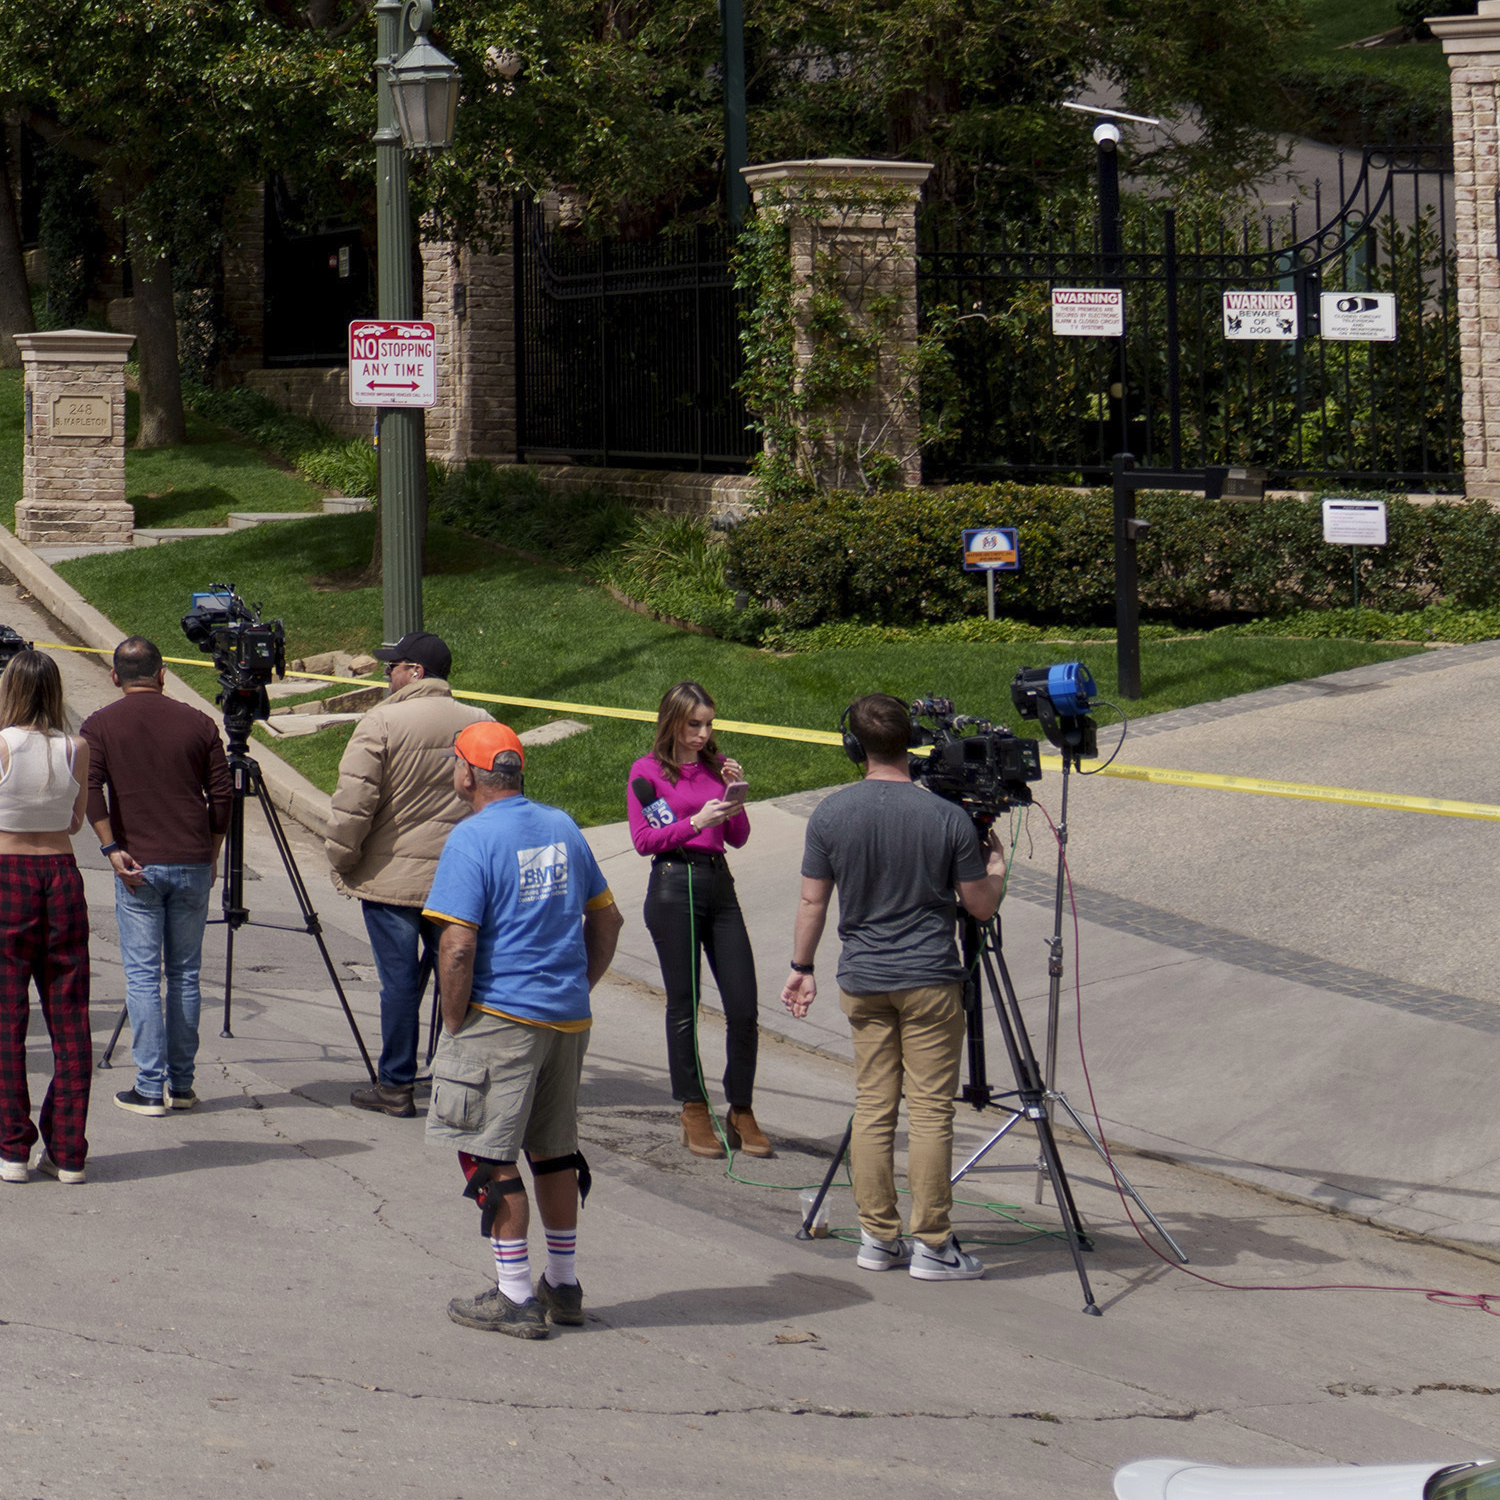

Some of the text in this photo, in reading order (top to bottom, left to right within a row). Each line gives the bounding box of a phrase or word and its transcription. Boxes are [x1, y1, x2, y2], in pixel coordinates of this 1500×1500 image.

[1055, 292, 1118, 304] WARNING
[1227, 295, 1292, 309] WARNING
[1253, 318, 1267, 326] OF
[1249, 326, 1271, 334] DOG
[353, 338, 432, 358] NO STOPPING
[362, 363, 424, 377] ANY TIME
[69, 403, 92, 415] 248
[64, 417, 107, 426] MAPLETON
[657, 806, 674, 825] 5
[525, 863, 564, 887] BMC
